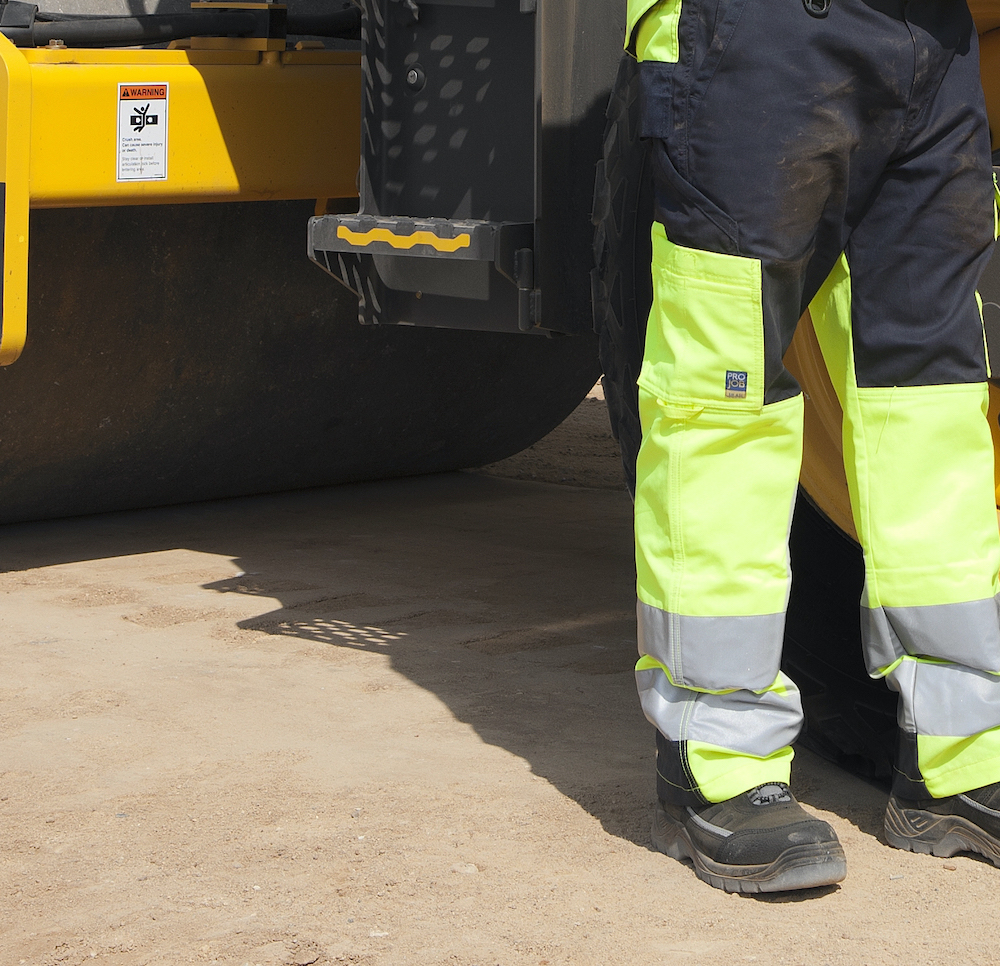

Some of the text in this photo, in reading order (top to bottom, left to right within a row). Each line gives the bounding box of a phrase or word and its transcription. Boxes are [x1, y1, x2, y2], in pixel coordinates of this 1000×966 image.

[130, 88, 165, 96] WARNING
[727, 372, 746, 381] PRO
[727, 379, 745, 389] JOB
